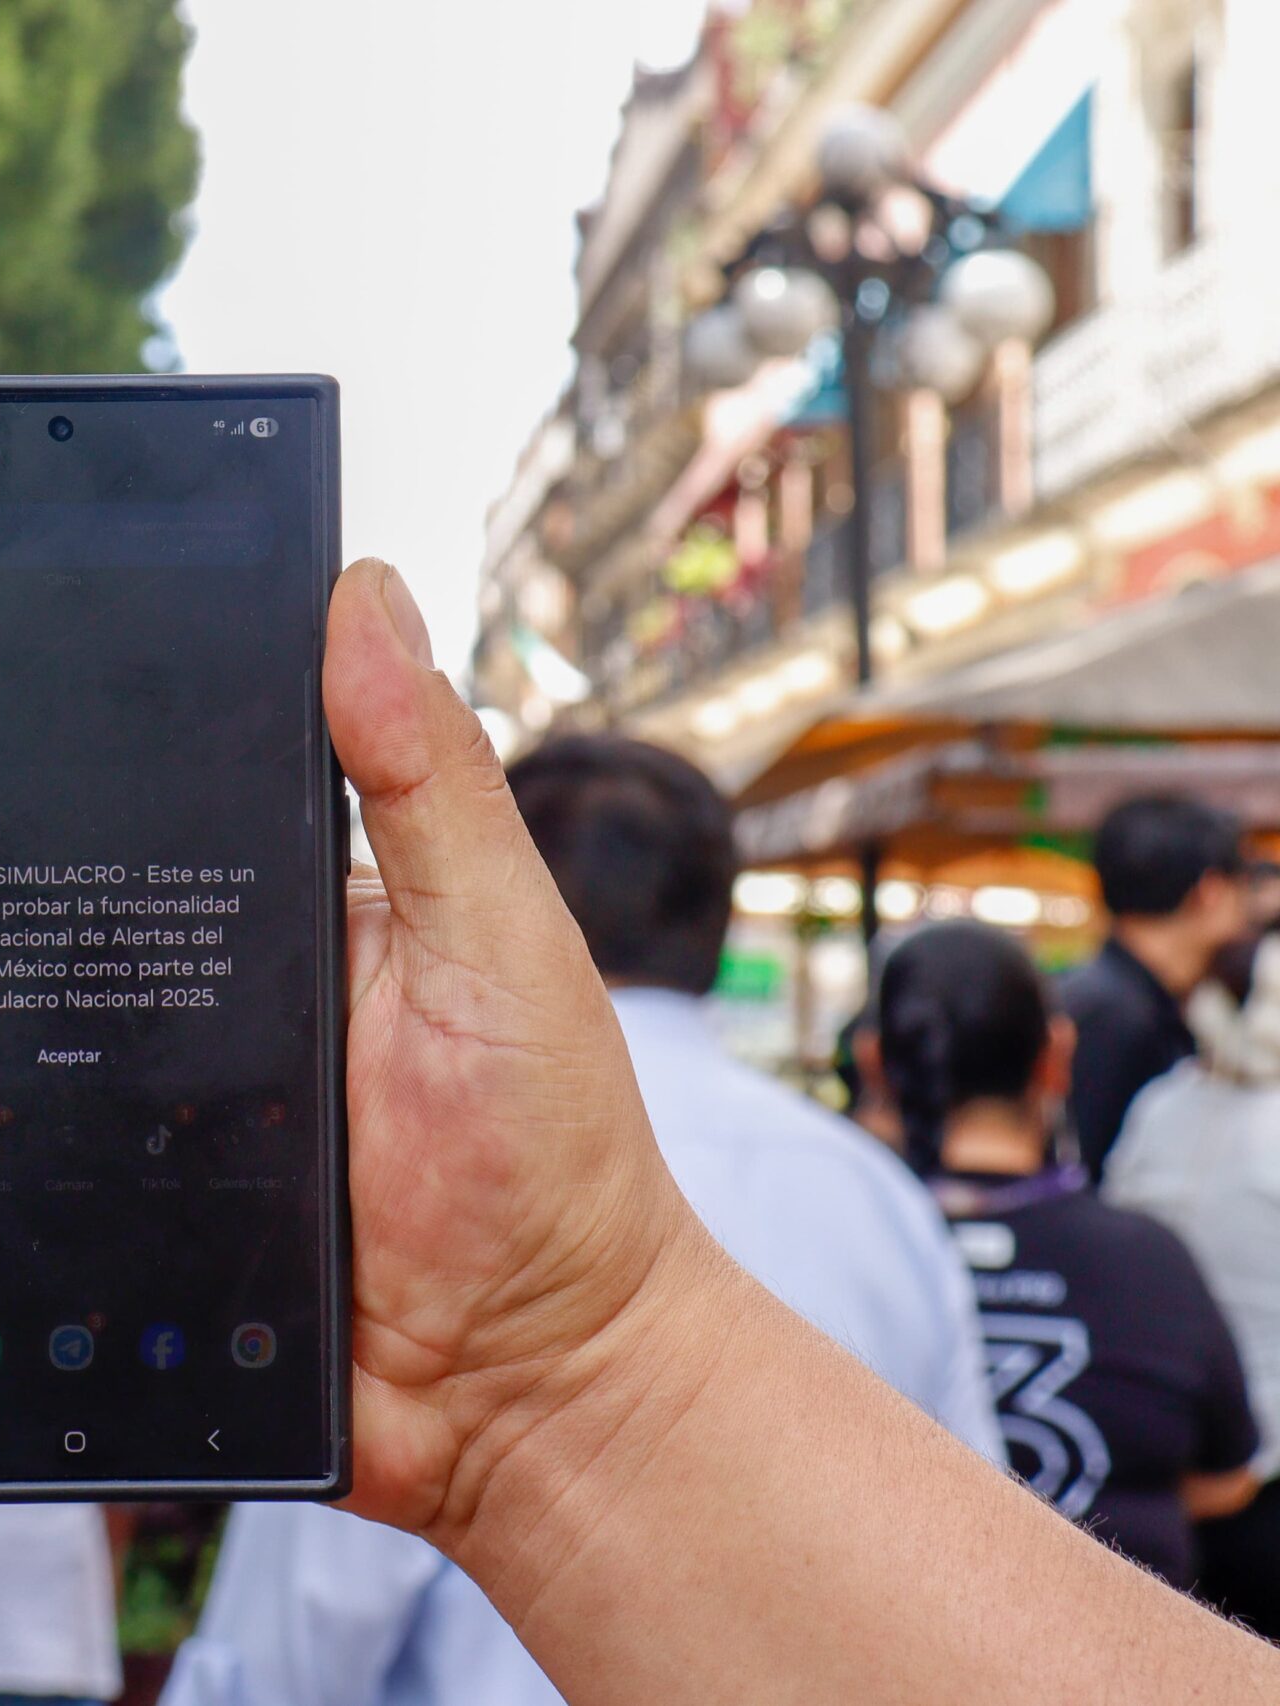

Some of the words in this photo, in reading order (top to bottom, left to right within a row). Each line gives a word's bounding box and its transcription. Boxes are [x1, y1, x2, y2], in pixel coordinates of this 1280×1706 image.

[212, 419, 226, 429] 4G
[256, 420, 272, 434] 61
[147, 864, 194, 884] Este
[199, 868, 224, 883] es
[229, 868, 255, 883] un
[2, 896, 72, 921] probar
[77, 896, 94, 916] la
[100, 894, 240, 915] funcionalidad
[79, 927, 106, 946] de
[111, 926, 186, 946] Alertas
[191, 925, 223, 945] del
[73, 962, 132, 977] como
[138, 959, 194, 981] parte
[200, 956, 232, 976] del
[65, 988, 154, 1009] Nacional
[161, 988, 220, 1008] 2025.
[36, 1047, 102, 1065] Aceptar
